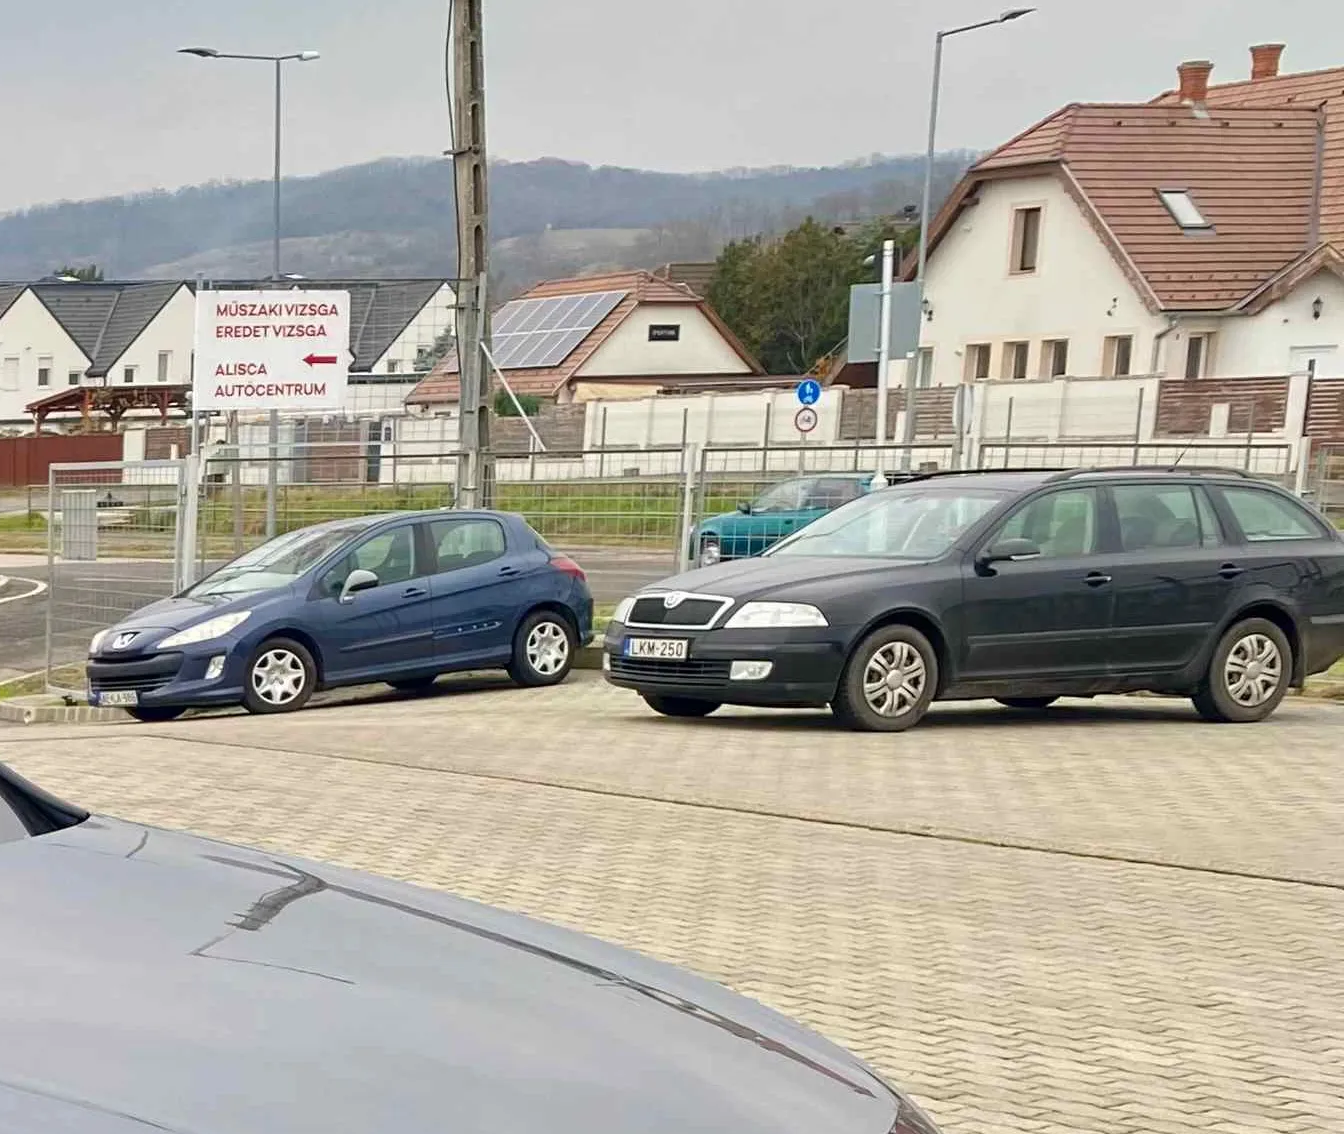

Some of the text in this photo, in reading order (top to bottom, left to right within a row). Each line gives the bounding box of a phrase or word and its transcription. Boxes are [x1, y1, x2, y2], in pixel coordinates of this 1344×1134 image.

[285, 304, 338, 316] VIZSGA
[215, 364, 267, 376] ALISCA
[632, 641, 683, 656] LKM-250
